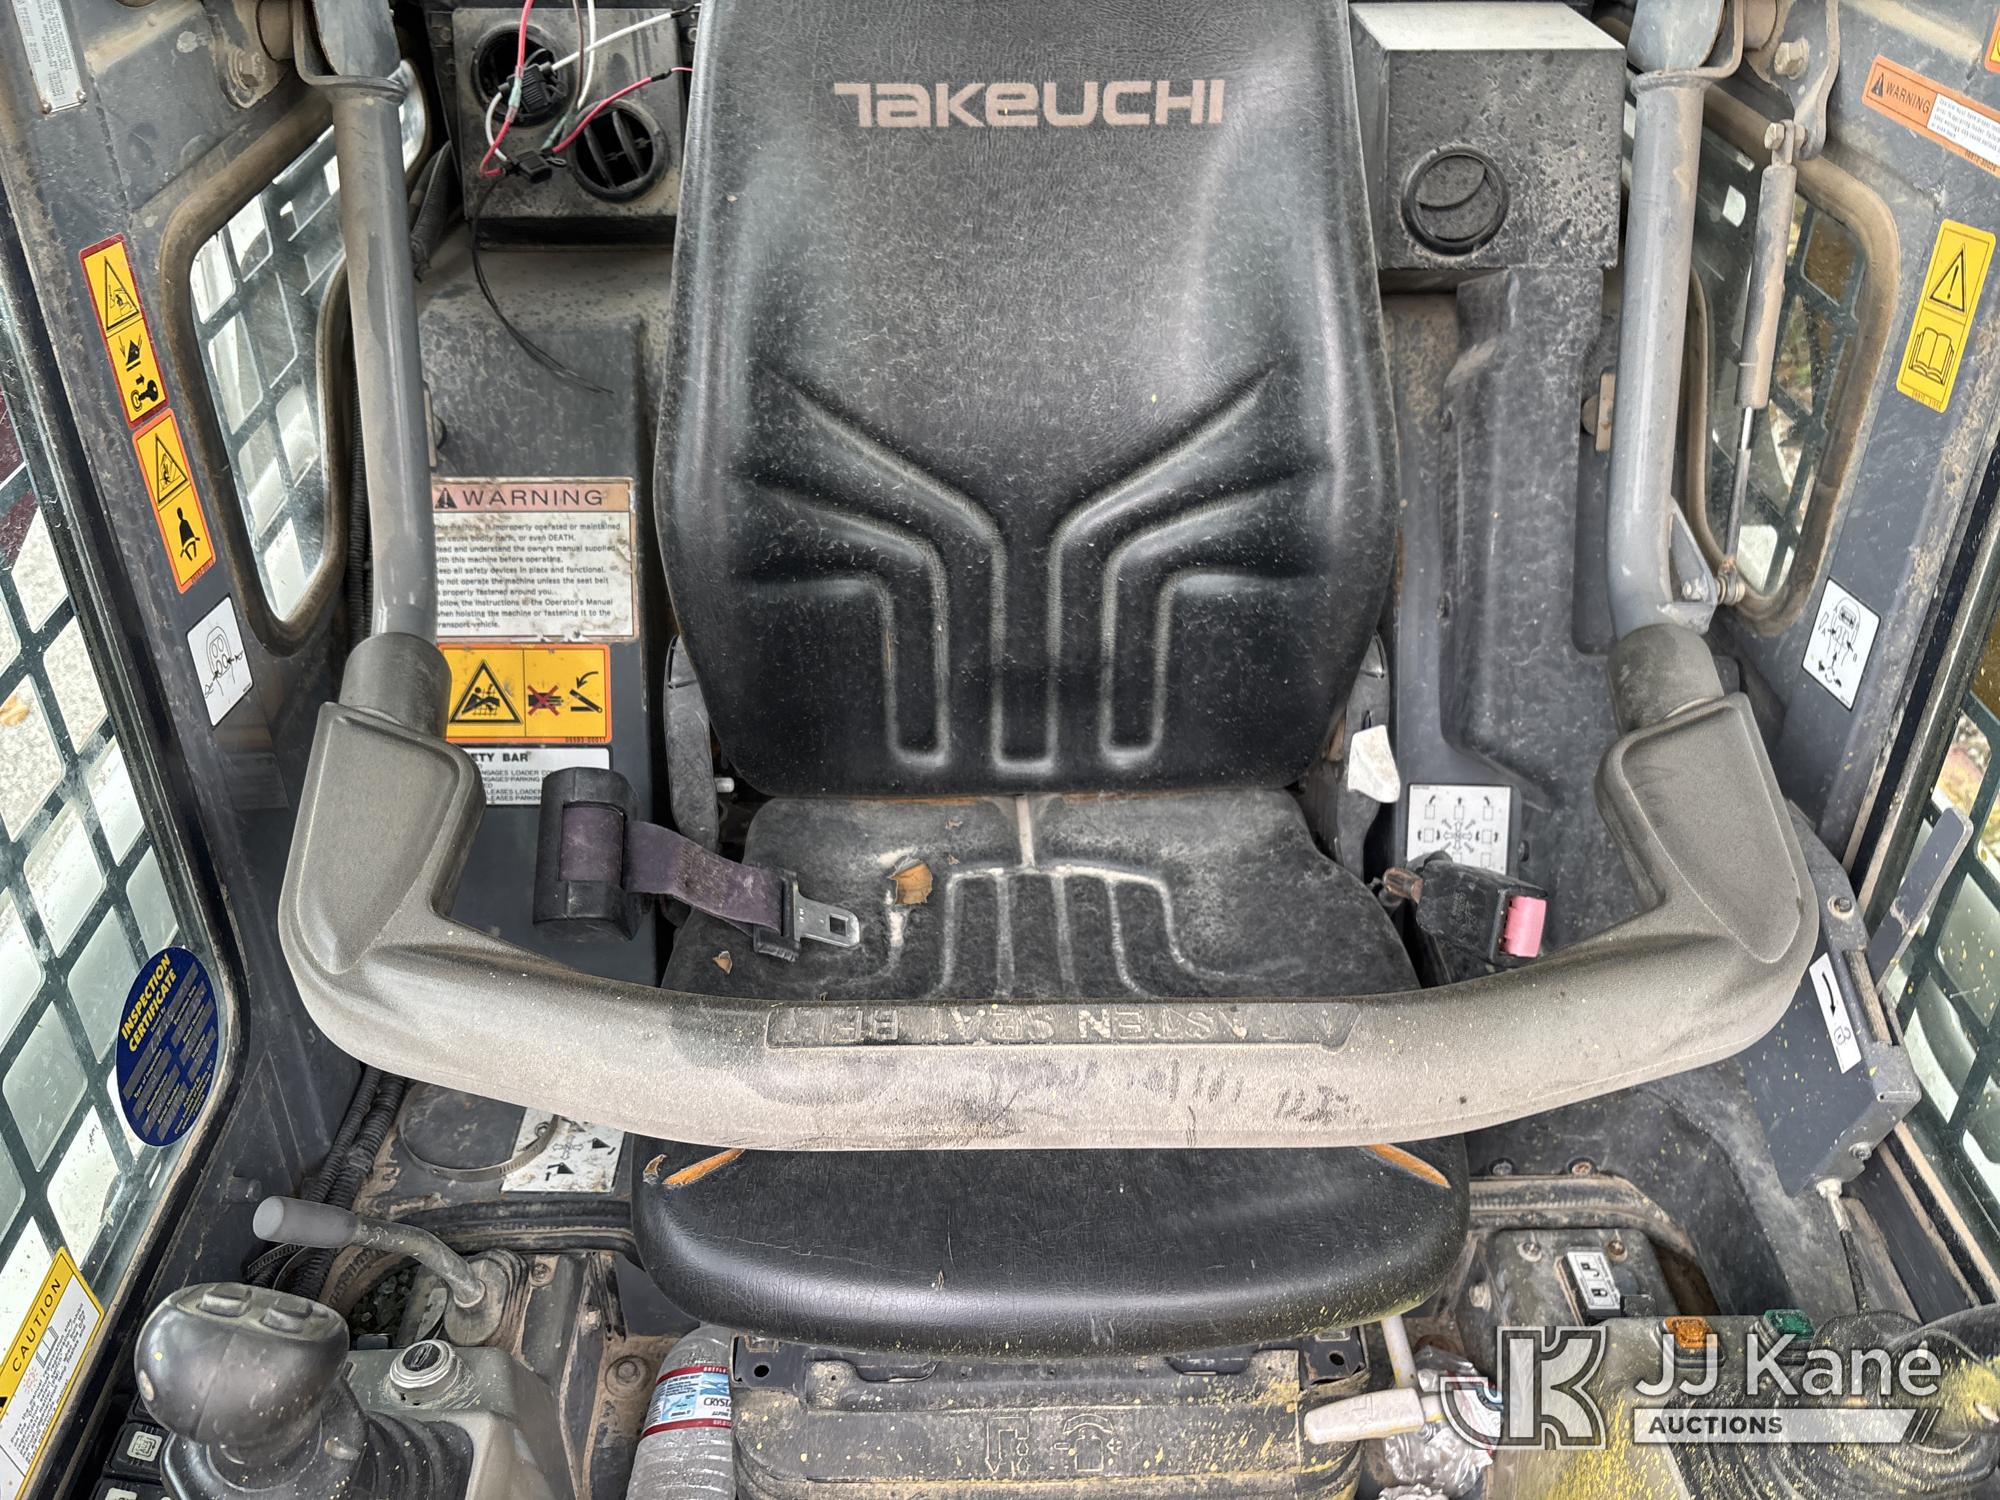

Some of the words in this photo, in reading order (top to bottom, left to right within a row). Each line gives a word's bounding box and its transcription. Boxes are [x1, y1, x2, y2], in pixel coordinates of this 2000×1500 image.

[1886, 82, 1931, 114] WARNING
[463, 489, 603, 505] WARNING
[535, 523, 567, 531] operated
[580, 522, 620, 530] maintained
[585, 544, 615, 553] supplied
[465, 567, 488, 575] safety
[528, 566, 548, 575] place
[461, 578, 489, 586] operate
[443, 589, 473, 597] properly
[510, 587, 536, 595] around
[456, 610, 485, 618] hoisting
[544, 609, 578, 618] fastening
[438, 621, 470, 629] ransport
[472, 620, 499, 628] vehicle.
[503, 753, 528, 762] BAR
[121, 953, 171, 1041] INSPECTION
[129, 968, 178, 1053] CERTIFICATE
[12, 1278, 62, 1373] CAUTION
